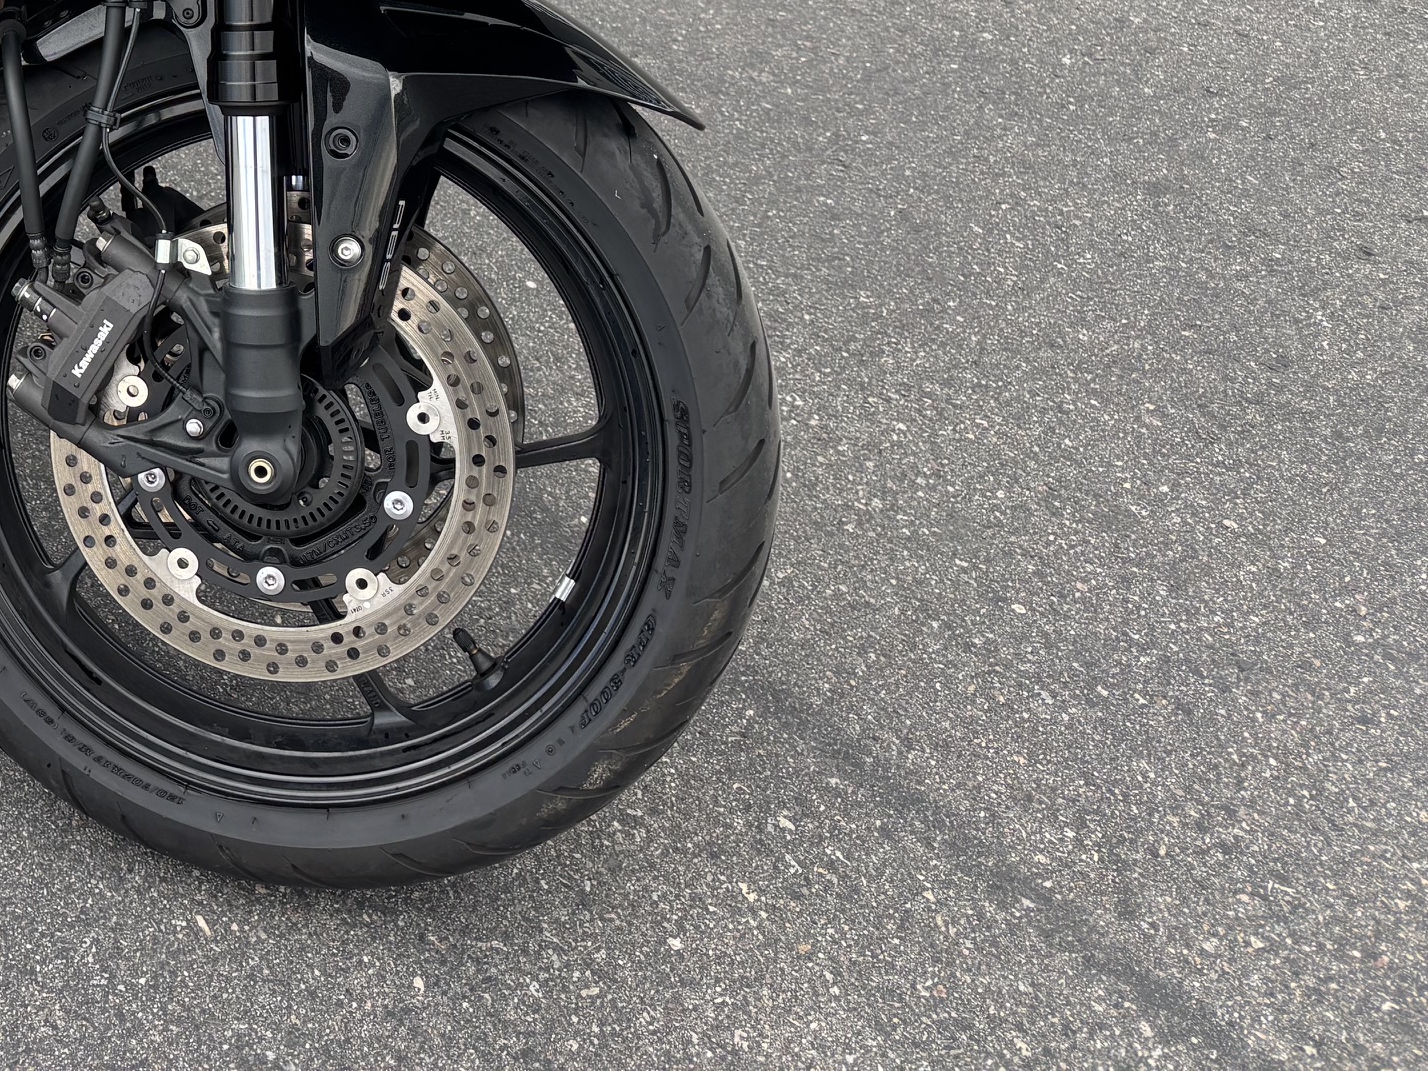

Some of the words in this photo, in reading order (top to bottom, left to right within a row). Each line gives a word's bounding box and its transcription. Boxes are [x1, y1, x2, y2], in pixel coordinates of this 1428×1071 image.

[378, 199, 406, 291] ABS
[71, 318, 115, 379] Kawasaki
[183, 495, 205, 515] DOT
[656, 397, 694, 601] SPORTMAX
